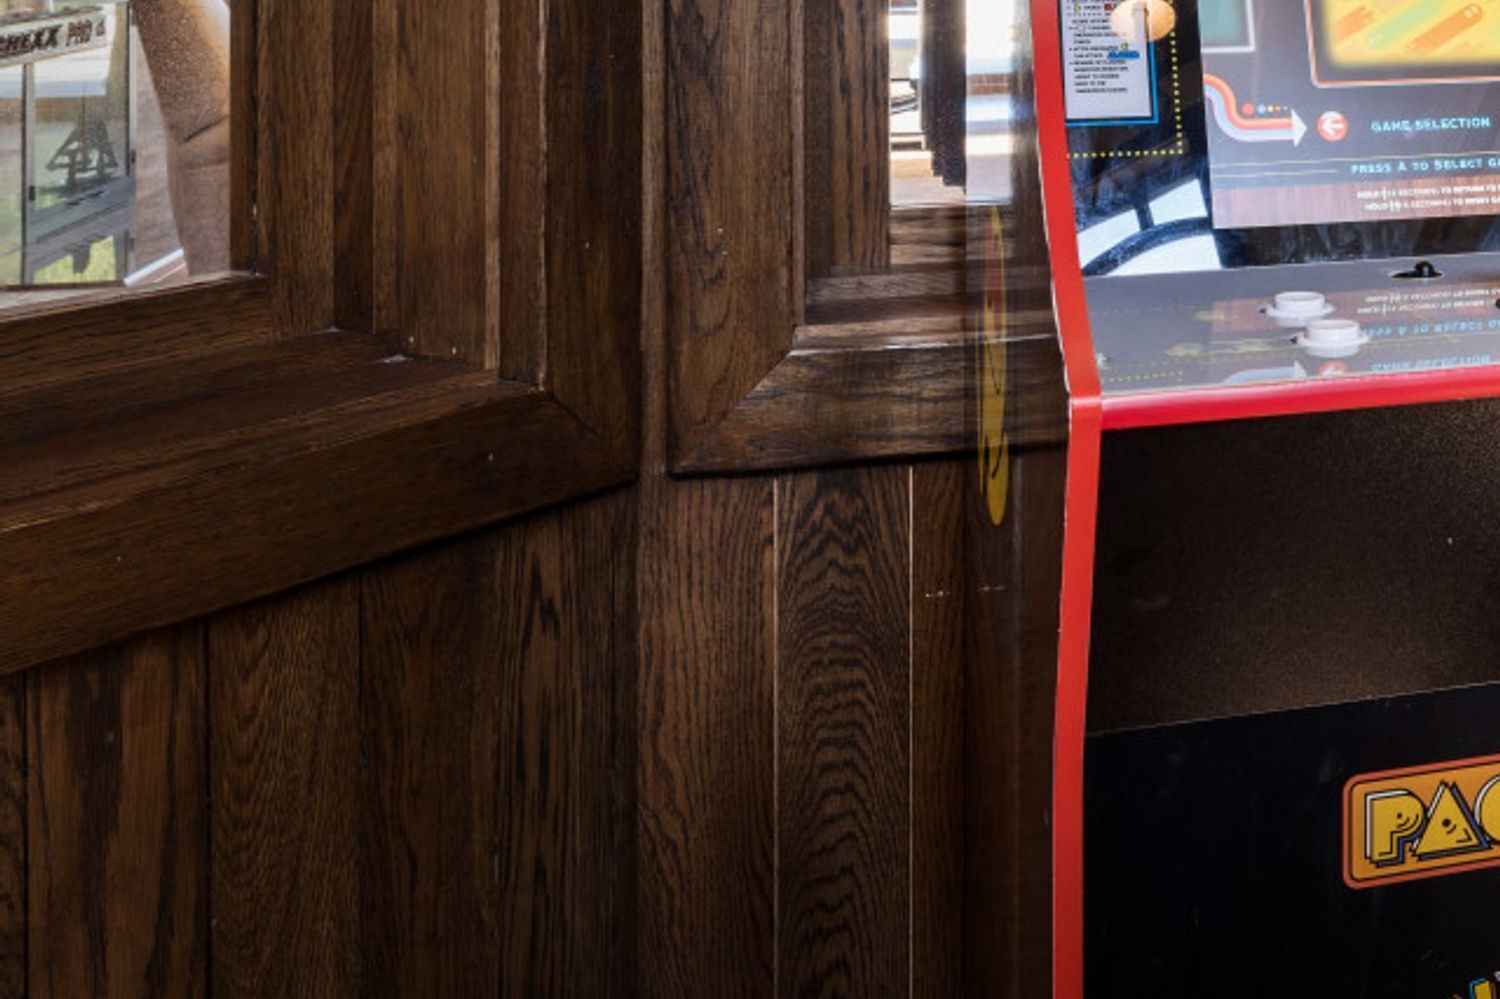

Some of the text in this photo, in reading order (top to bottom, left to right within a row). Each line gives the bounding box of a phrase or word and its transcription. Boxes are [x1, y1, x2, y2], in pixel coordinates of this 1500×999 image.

[1371, 117, 1491, 132] GAME SELECTION
[1351, 161, 1392, 174] PRESS
[1399, 161, 1408, 173] A
[1413, 161, 1429, 172] TO
[1434, 157, 1483, 171] SELECT
